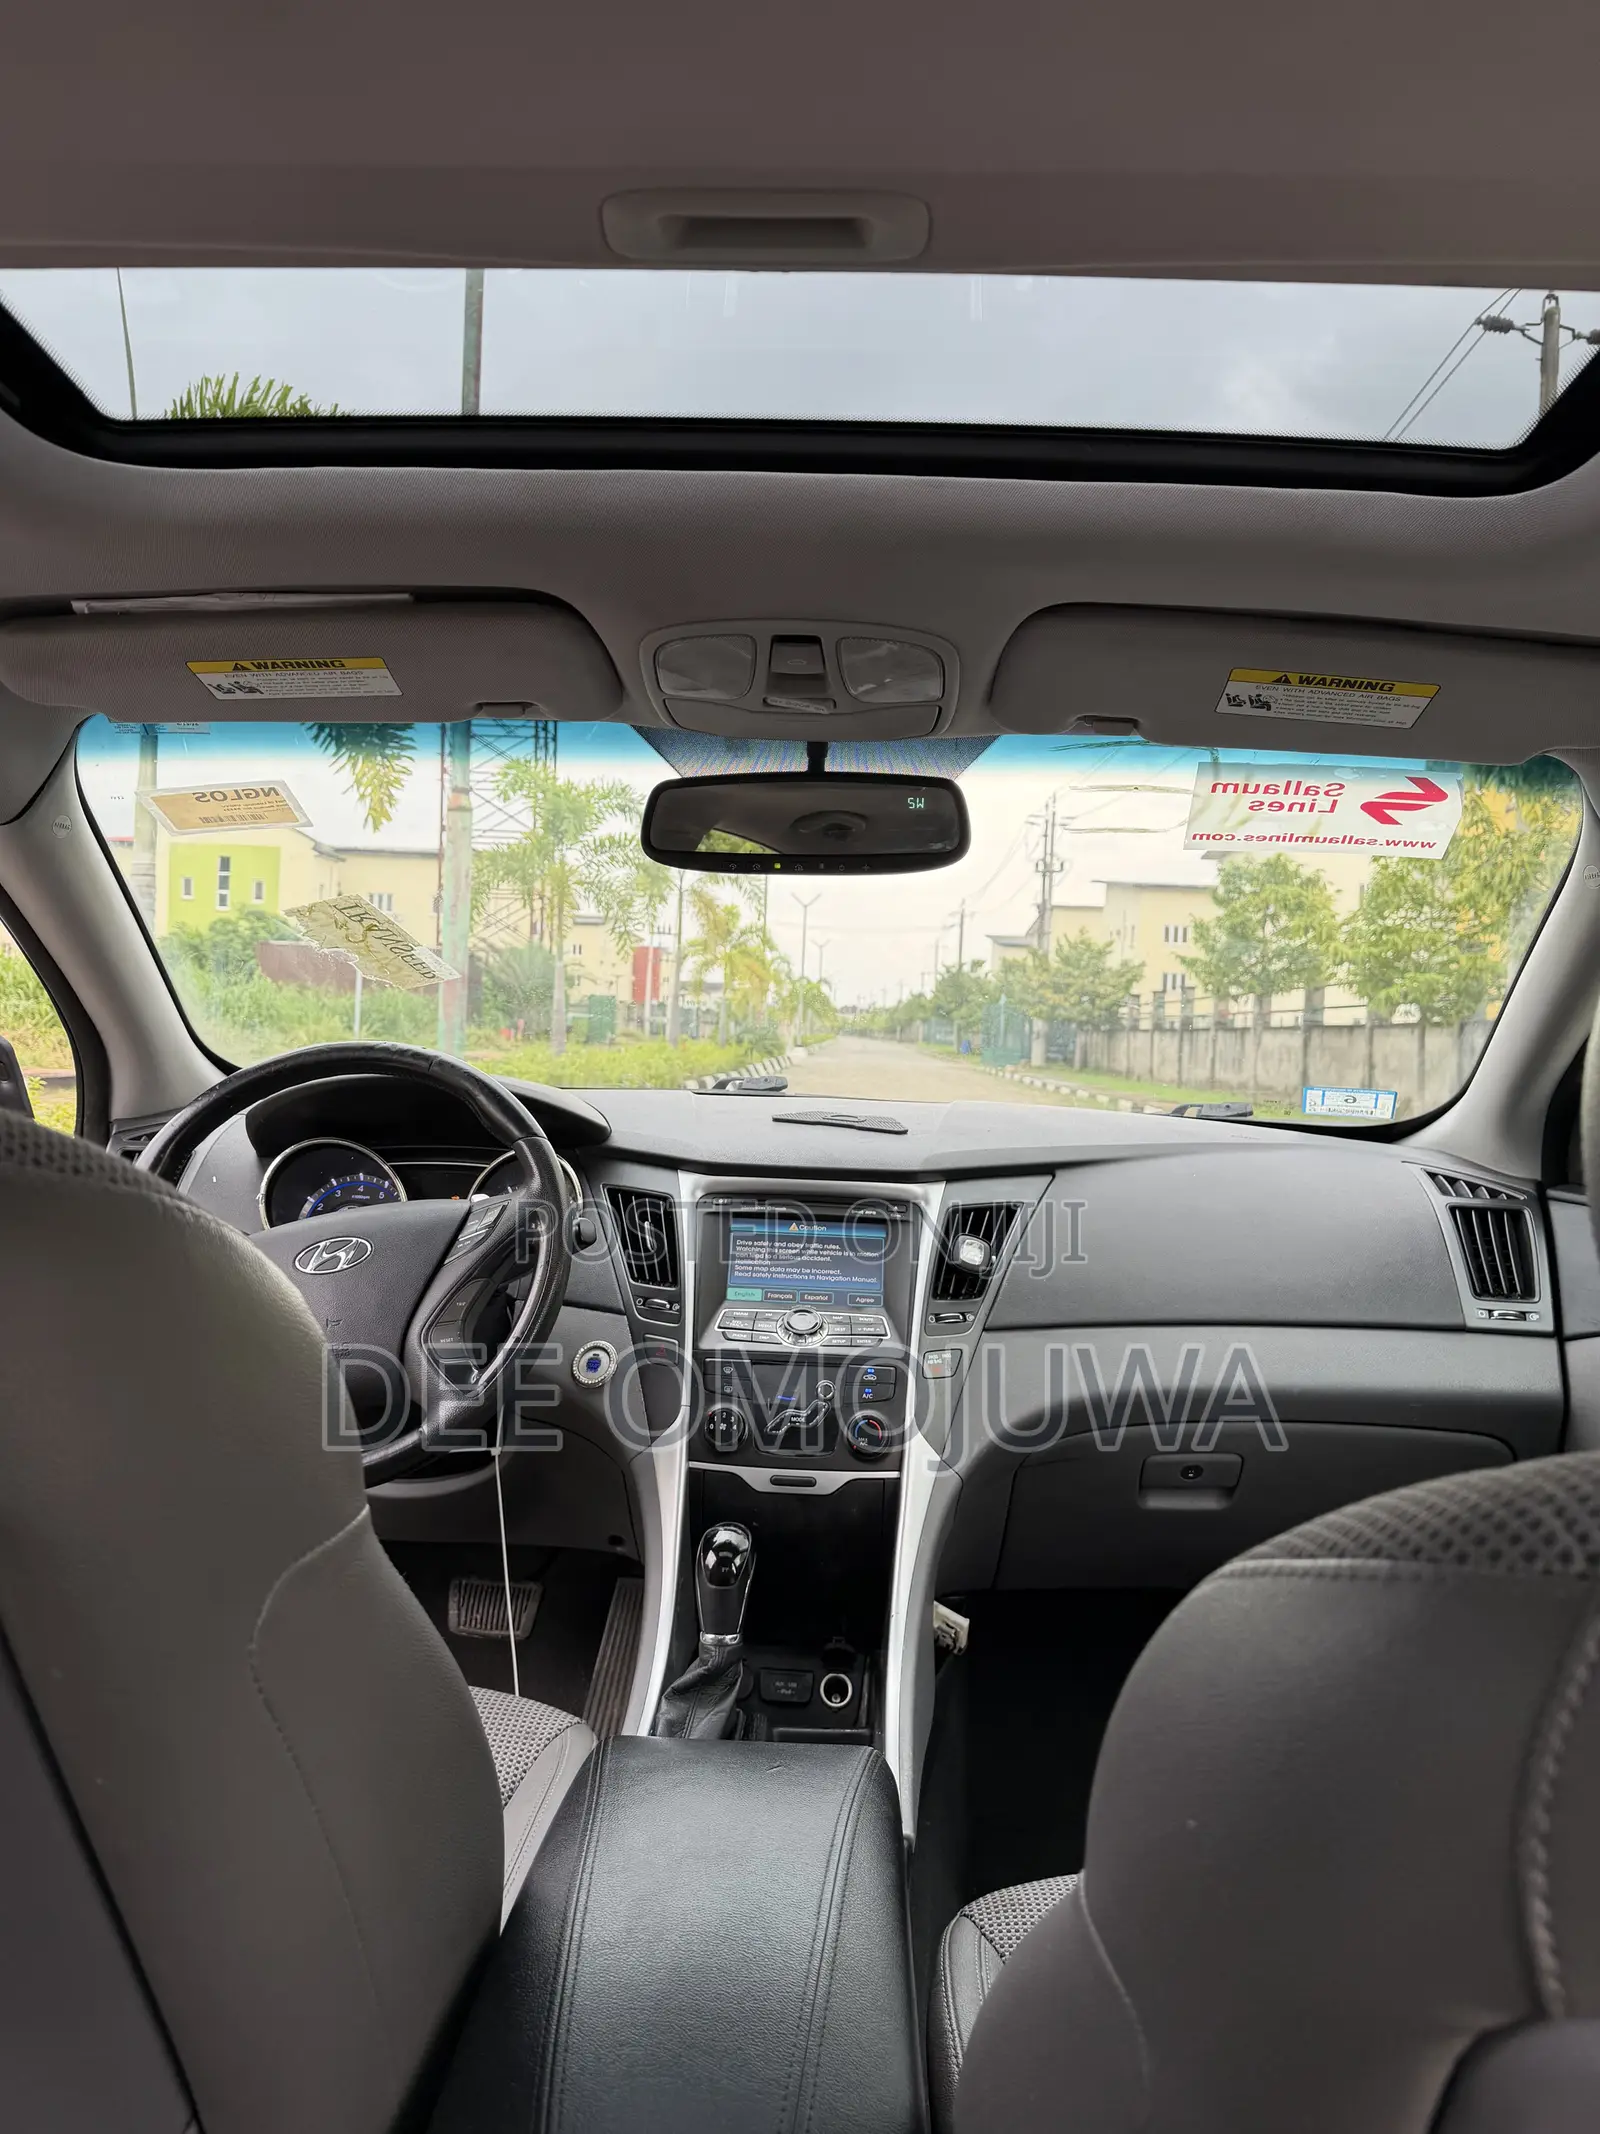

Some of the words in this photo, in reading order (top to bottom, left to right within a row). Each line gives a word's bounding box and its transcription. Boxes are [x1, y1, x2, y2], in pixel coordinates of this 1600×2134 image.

[251, 660, 346, 671] WARNING
[1298, 674, 1396, 693] WARNING
[1255, 684, 1280, 693] EVEN
[1282, 686, 1306, 694] WITH
[1307, 689, 1356, 698] ADVANCED
[907, 797, 925, 809] SW
[335, 1189, 342, 1197] 3
[379, 1191, 385, 1199] 5
[317, 1203, 324, 1211] 2
[799, 1224, 827, 1232] Caution
[753, 1239, 773, 1248] safely
[787, 1241, 803, 1249] obey
[824, 1242, 841, 1250] rules.
[736, 1245, 766, 1254] Watching
[752, 1271, 771, 1279] safety
[772, 1272, 808, 1280] instructions
[816, 1274, 851, 1282] Navigation
[734, 1291, 755, 1299] English
[767, 1291, 793, 1301] Français
[804, 1293, 829, 1302] Español
[855, 1296, 875, 1304] Agree
[722, 1411, 727, 1419] 2
[730, 1415, 735, 1423] 3
